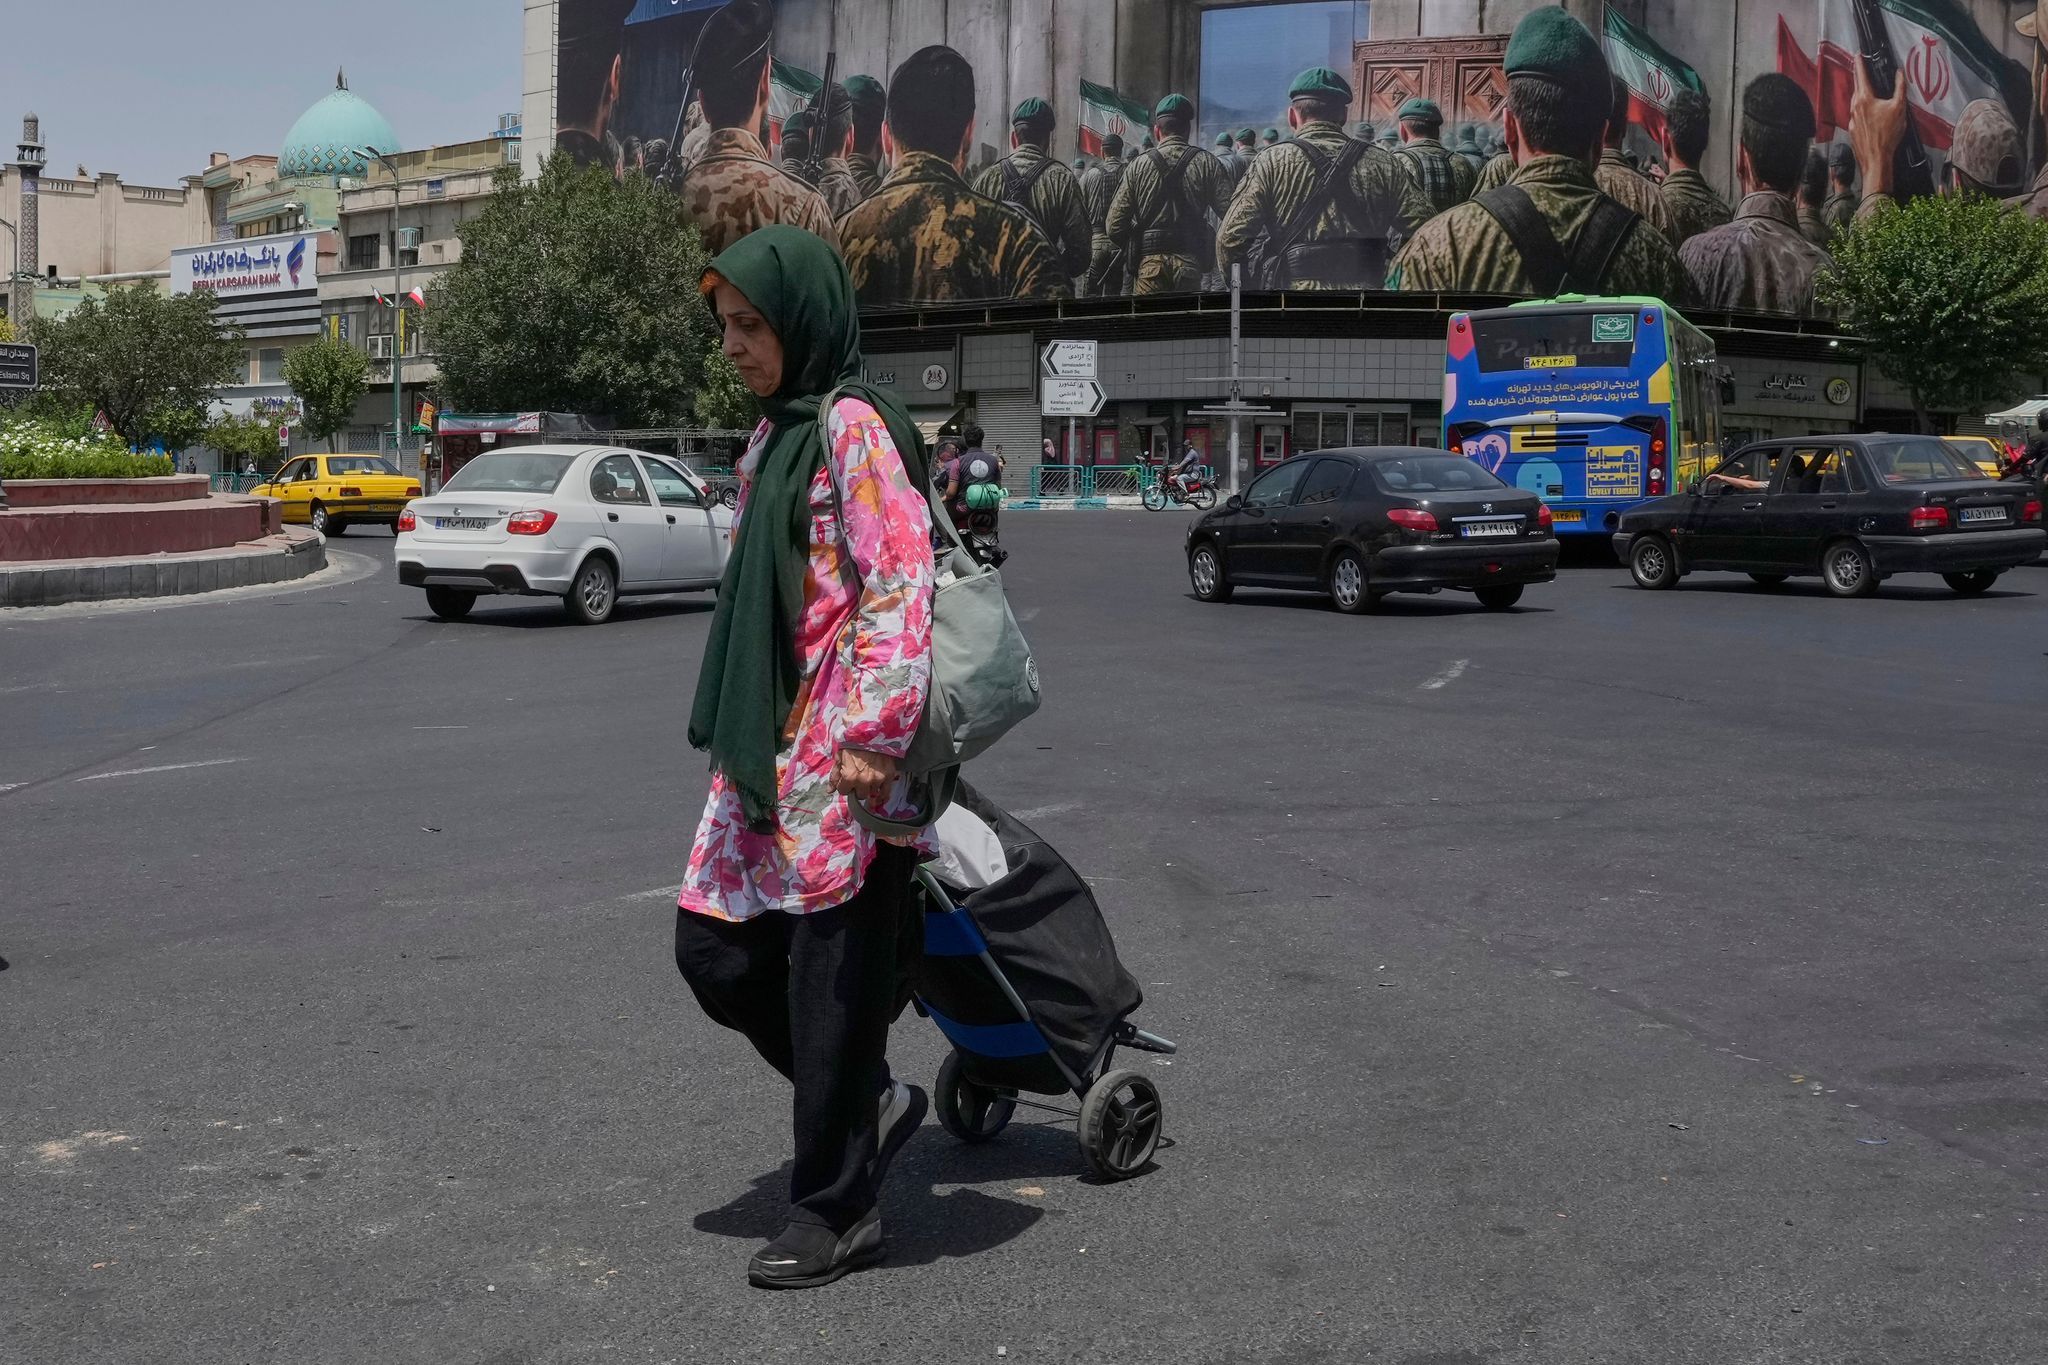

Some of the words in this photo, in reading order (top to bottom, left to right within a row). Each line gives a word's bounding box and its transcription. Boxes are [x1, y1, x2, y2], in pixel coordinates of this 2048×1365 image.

[192, 251, 226, 274] کارگران
[226, 247, 252, 269] رفاه
[216, 275, 258, 288] KARGARAN
[259, 273, 280, 285] BANK
[8, 348, 29, 360] میدان
[21, 372, 29, 382] Sq
[1766, 376, 1782, 388] ملی
[1783, 374, 1807, 389] کفش
[1508, 384, 1531, 394] تهرانه
[1533, 384, 1552, 393] جدید
[1553, 383, 1569, 392] های
[1571, 382, 1601, 391] اتوبوس
[1602, 381, 1608, 389] از
[1609, 380, 1625, 390] یکی
[1626, 380, 1639, 389] این
[1487, 396, 1516, 406] خریداری
[1518, 394, 1558, 405] شهروندان
[1577, 393, 1603, 402] عوارض
[1605, 393, 1619, 402] پول
[1621, 392, 1627, 401] با
